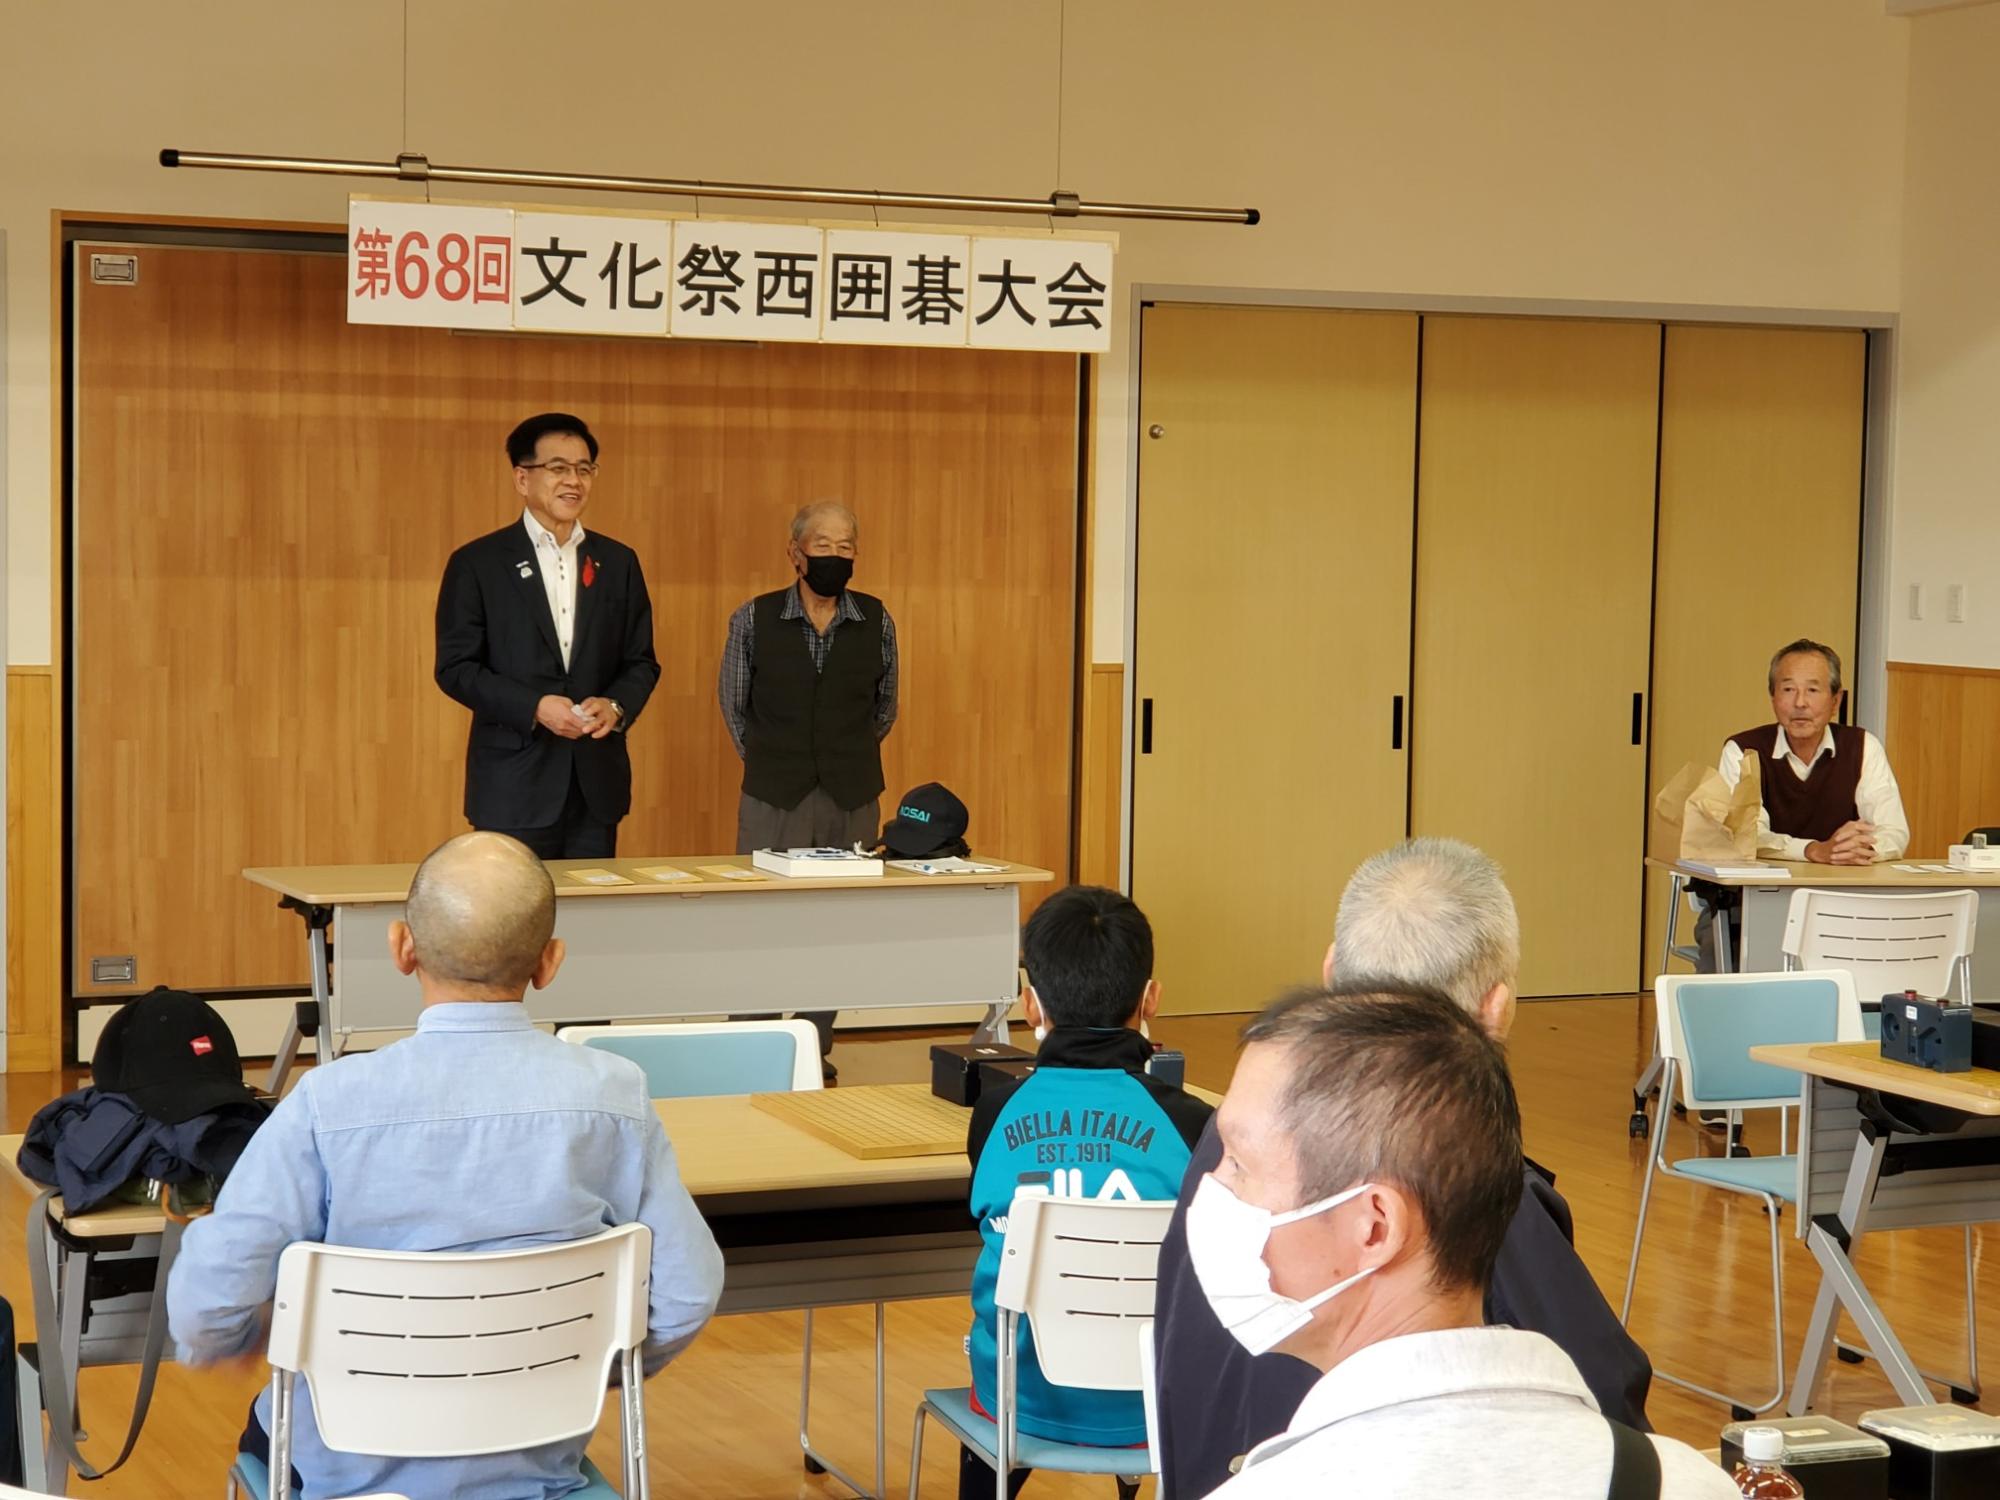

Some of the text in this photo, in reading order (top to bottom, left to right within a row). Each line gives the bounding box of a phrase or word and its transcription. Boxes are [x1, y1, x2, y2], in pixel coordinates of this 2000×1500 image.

[354, 227, 1107, 330] 第68回文化祭西囲碁大会
[1003, 1110, 1155, 1152] BIELLA ITALIA
